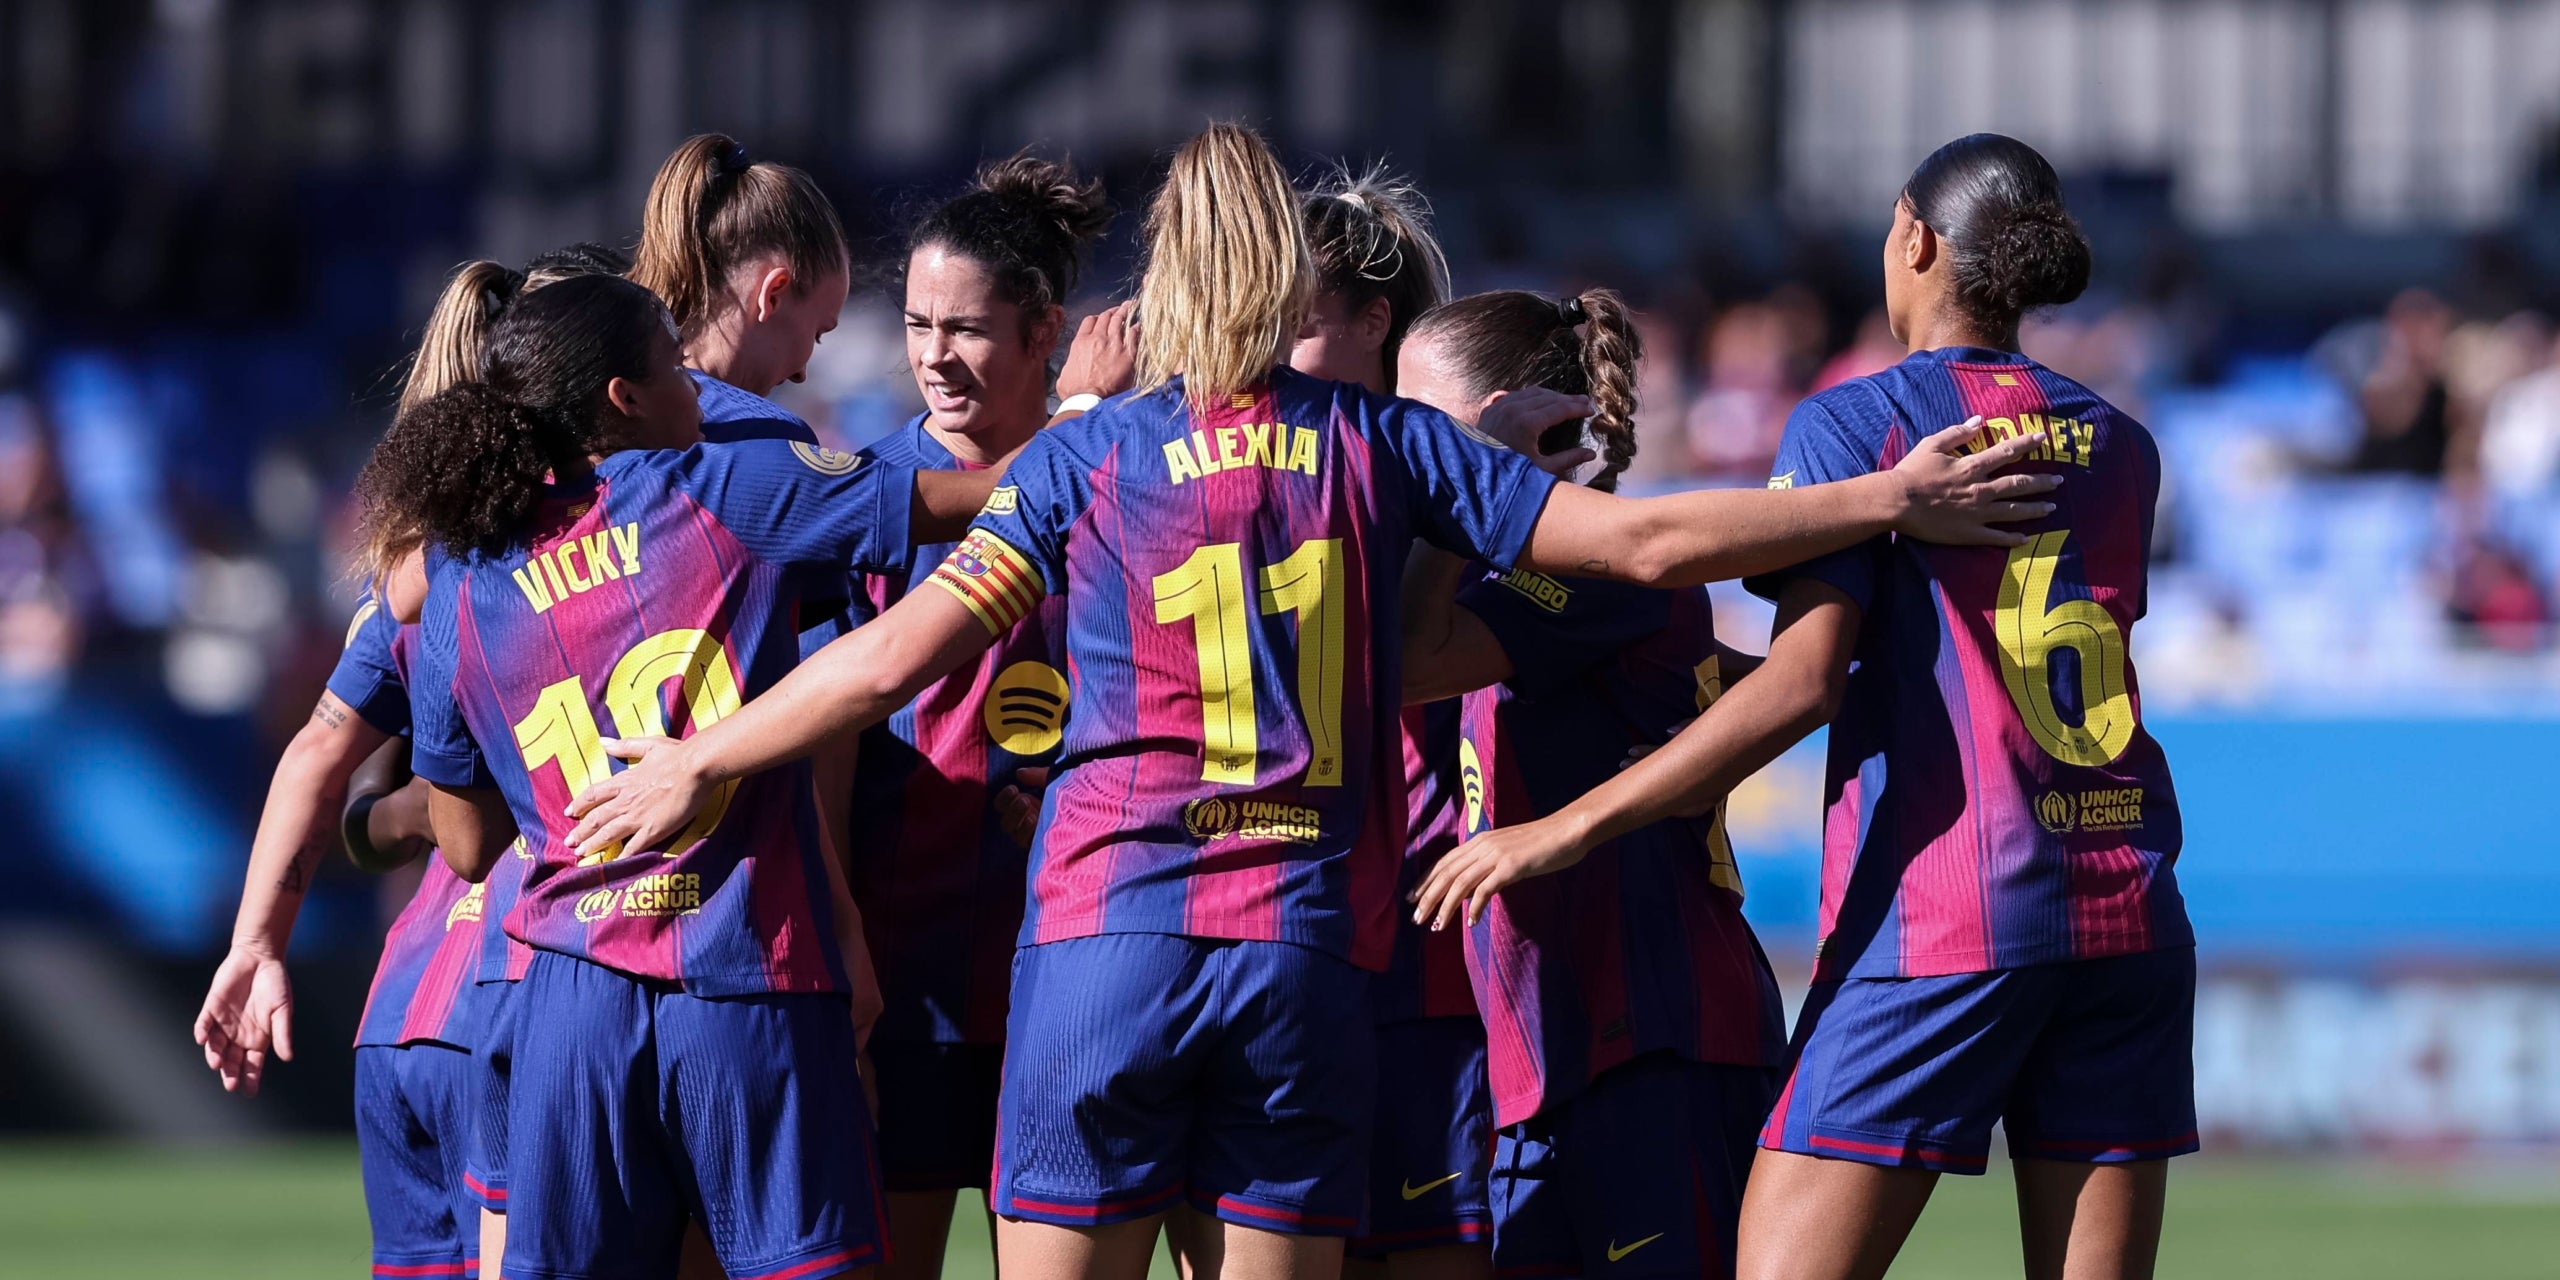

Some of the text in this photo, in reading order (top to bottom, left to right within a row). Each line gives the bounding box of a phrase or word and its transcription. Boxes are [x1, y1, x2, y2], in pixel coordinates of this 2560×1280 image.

[1949, 414, 2094, 467] DNEY
[1162, 422, 1318, 485] ALEXIA
[512, 522, 640, 614] VICKY
[937, 572, 971, 597] CAPITANA
[1995, 529, 2135, 766] 6
[1152, 537, 1344, 786] 11
[2080, 788, 2143, 808] UNHCR
[1242, 801, 1320, 826] UNHCR
[2080, 805, 2142, 825] ACNUR
[1239, 818, 1320, 842] ACNUR
[621, 890, 700, 909] ACNUR
